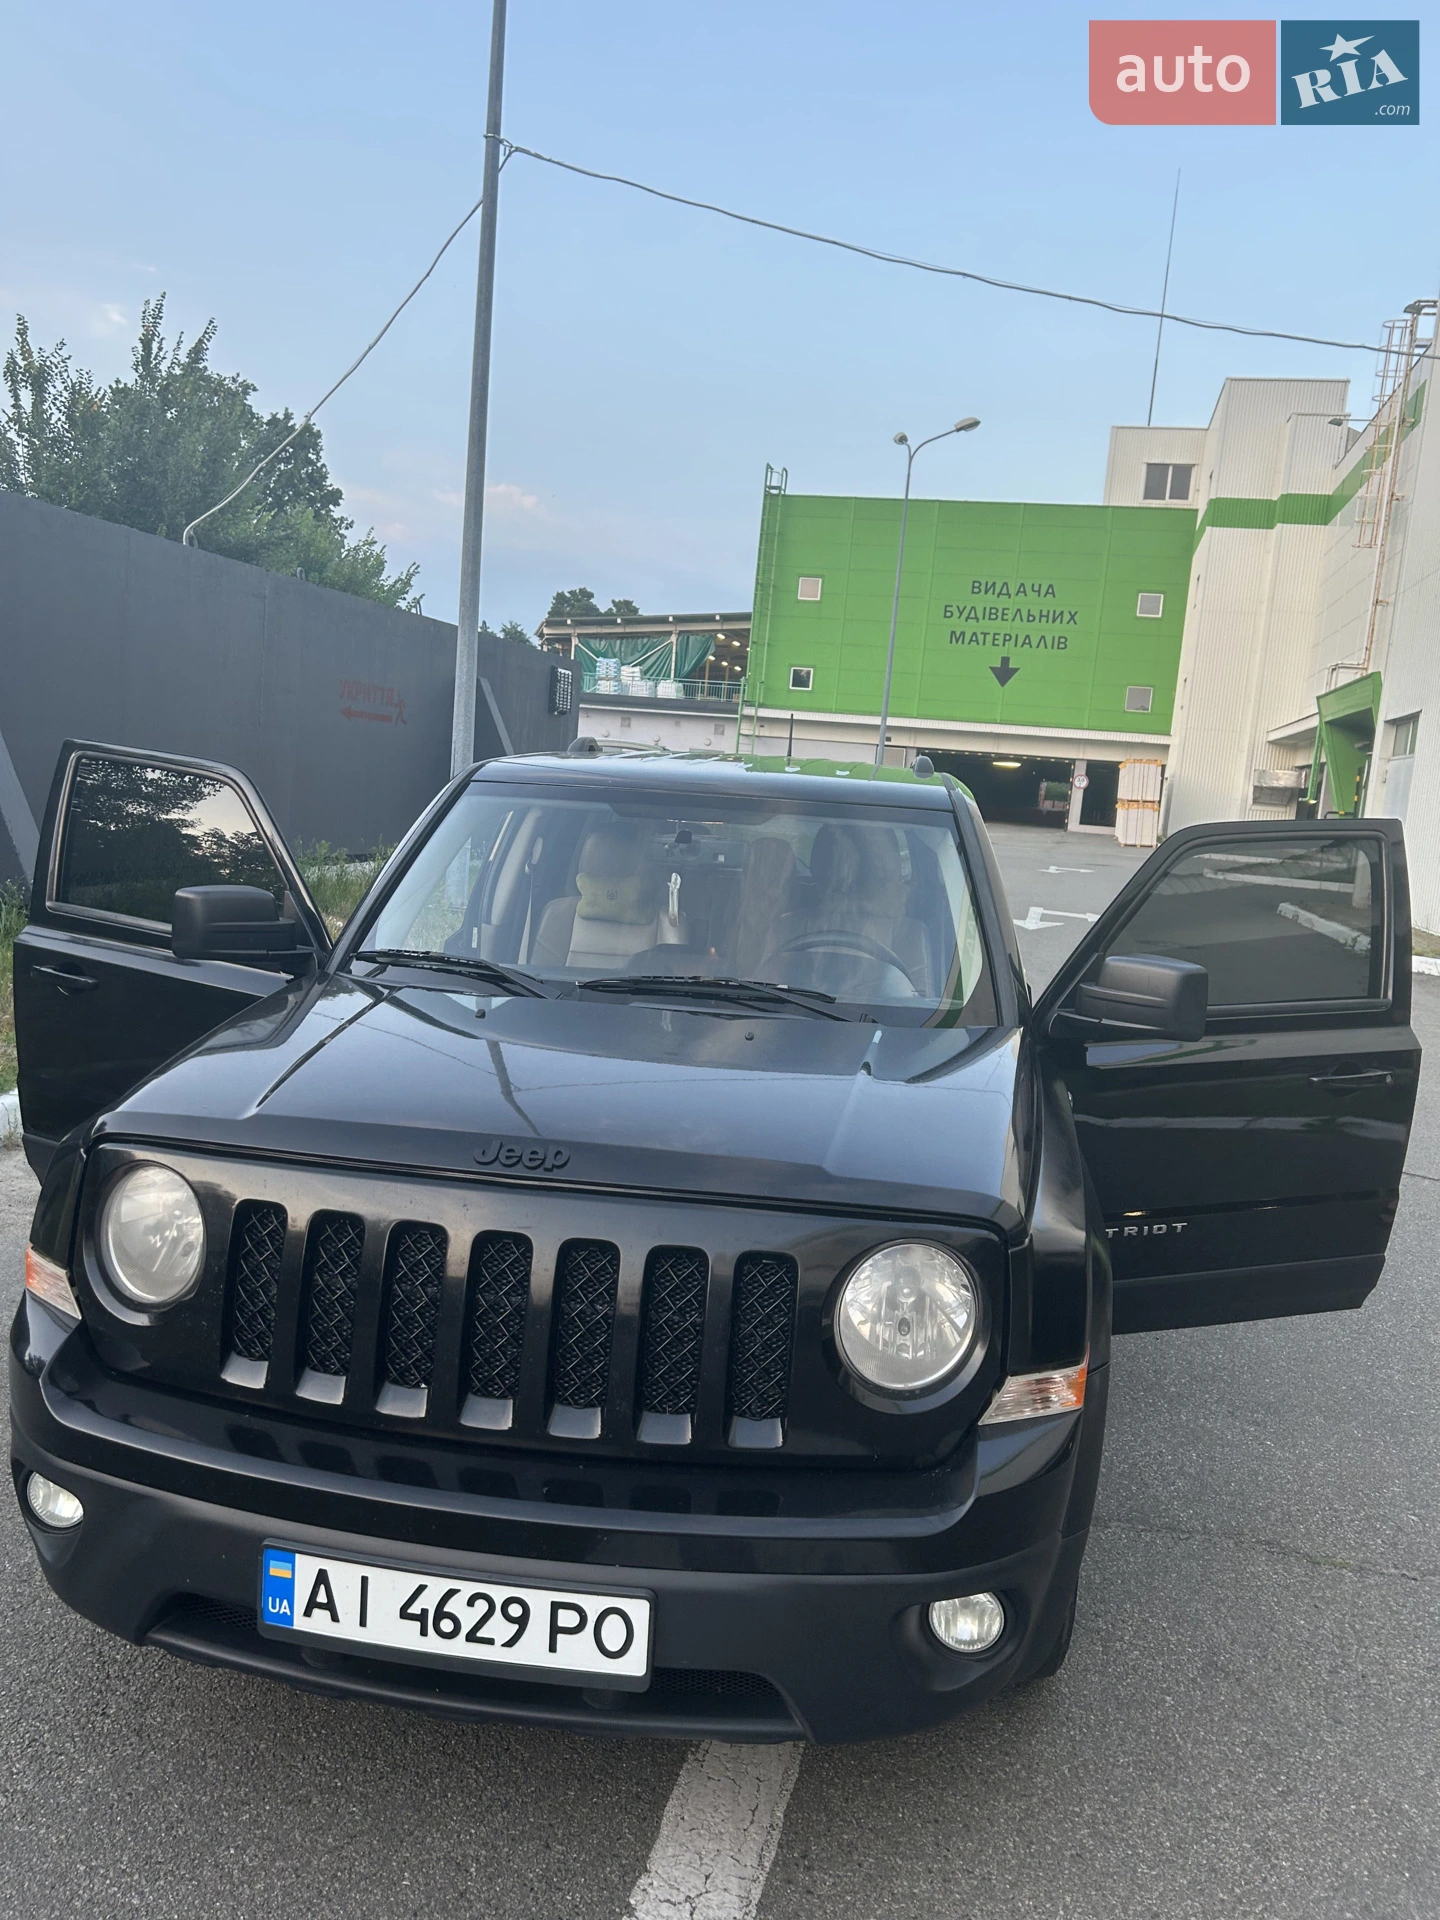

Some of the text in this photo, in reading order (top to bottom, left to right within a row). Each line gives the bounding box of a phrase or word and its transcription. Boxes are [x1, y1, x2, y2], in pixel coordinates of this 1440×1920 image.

[971, 580, 1056, 599] ВИДАЧА
[943, 604, 1079, 625] БУДІВЕЛЬНИХ
[949, 630, 1068, 650] МАТЕРІАЛІВ
[473, 1140, 570, 1172] Jeep
[268, 1596, 291, 1616] UA
[303, 1568, 635, 1660] AI 4629 PO
